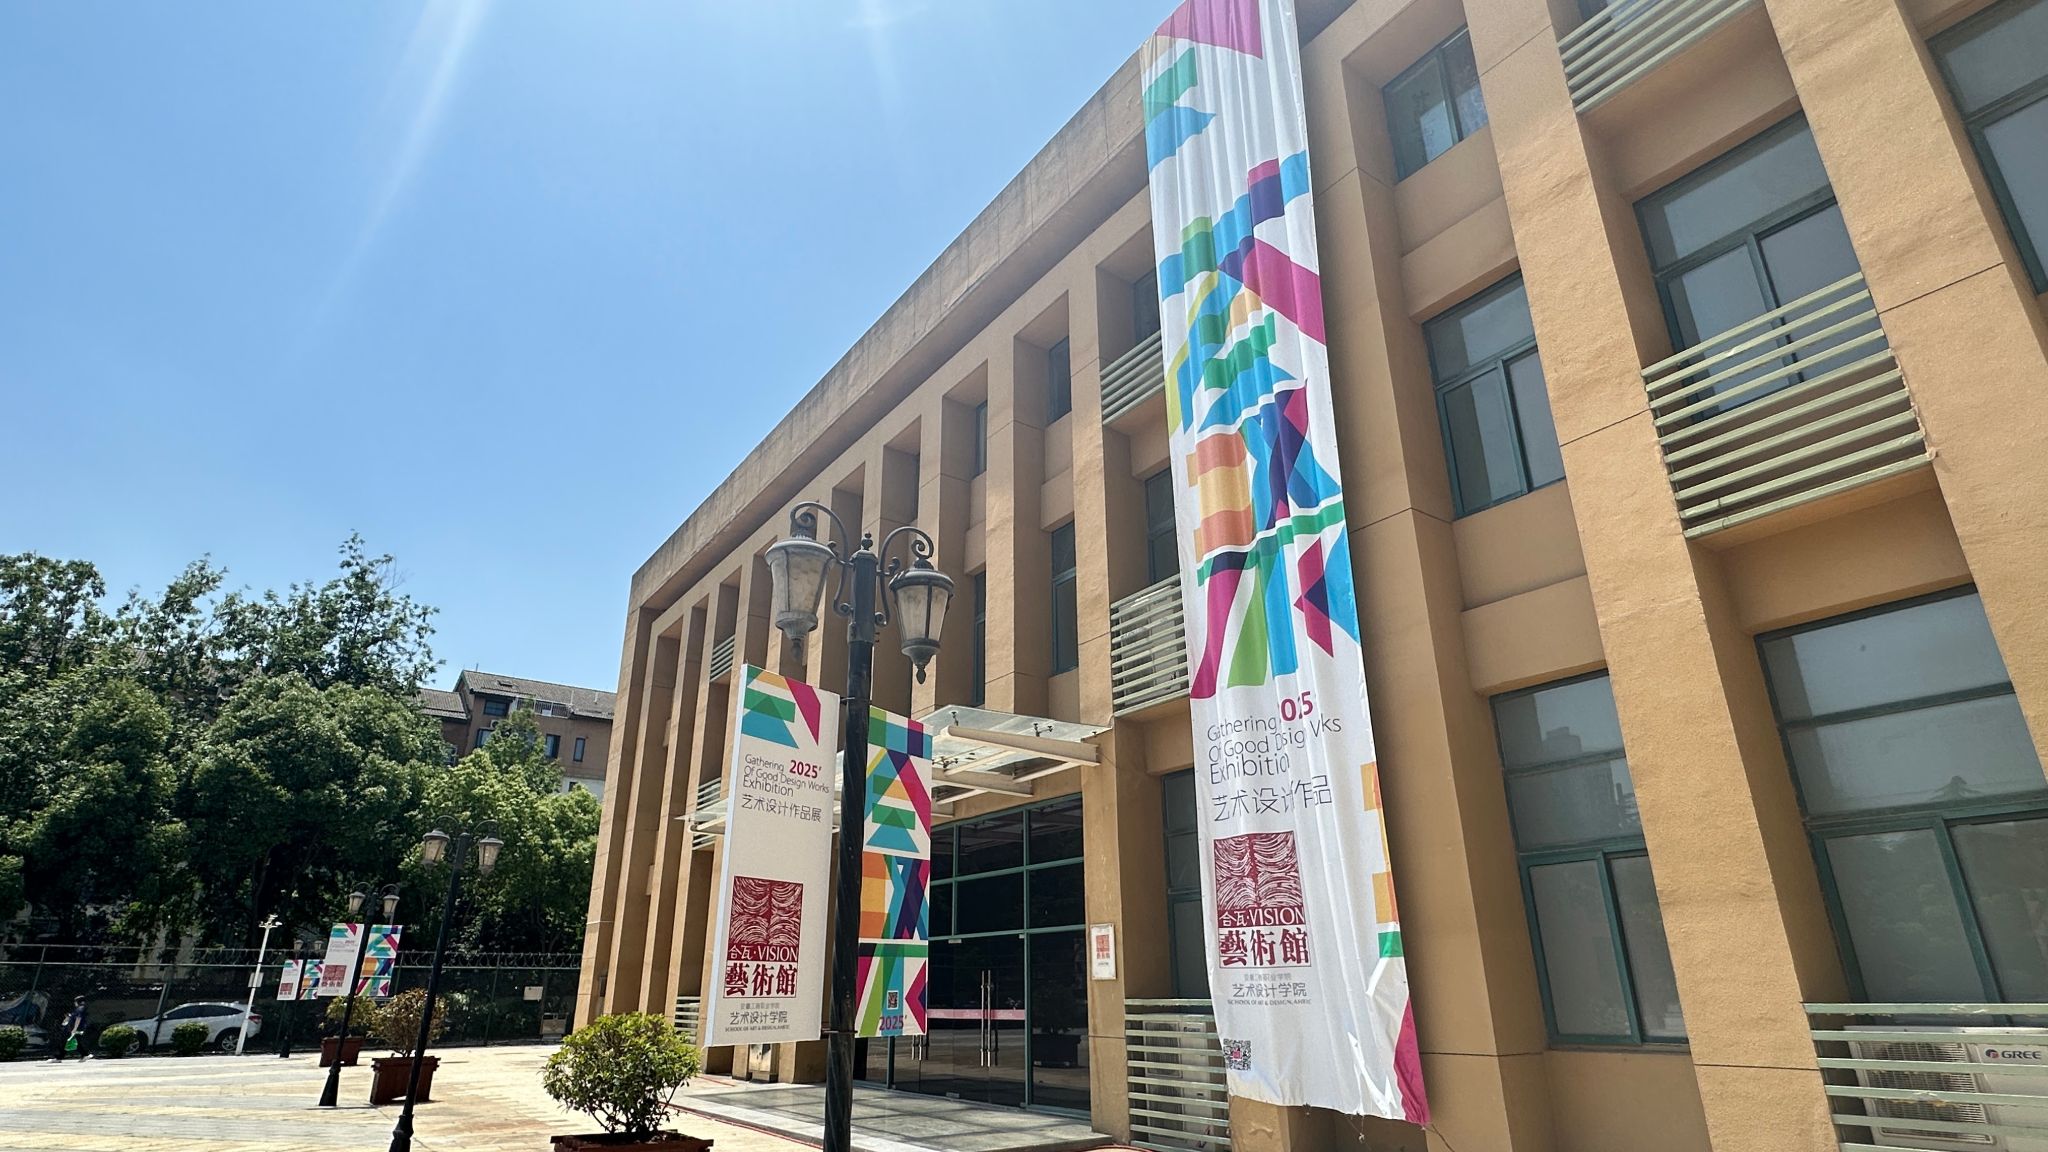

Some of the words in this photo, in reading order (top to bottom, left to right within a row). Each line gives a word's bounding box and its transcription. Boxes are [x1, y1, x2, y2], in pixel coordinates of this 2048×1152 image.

[1224, 735, 1270, 757] Good
[1274, 727, 1305, 751] Dsig
[744, 753, 785, 772] Gathering
[742, 774, 794, 797] Exhibition
[743, 765, 755, 777] Of
[755, 768, 779, 782] Good
[780, 772, 807, 789] Design
[807, 781, 830, 794] Works
[741, 793, 822, 823] 艺术设计作品展
[1218, 927, 1310, 966] 藝術館
[726, 962, 798, 996] 藝術館
[1232, 982, 1308, 998] 艺术设计学院
[729, 1010, 788, 1025] 艺术设计学院
[2001, 1049, 2042, 1060] GREE
